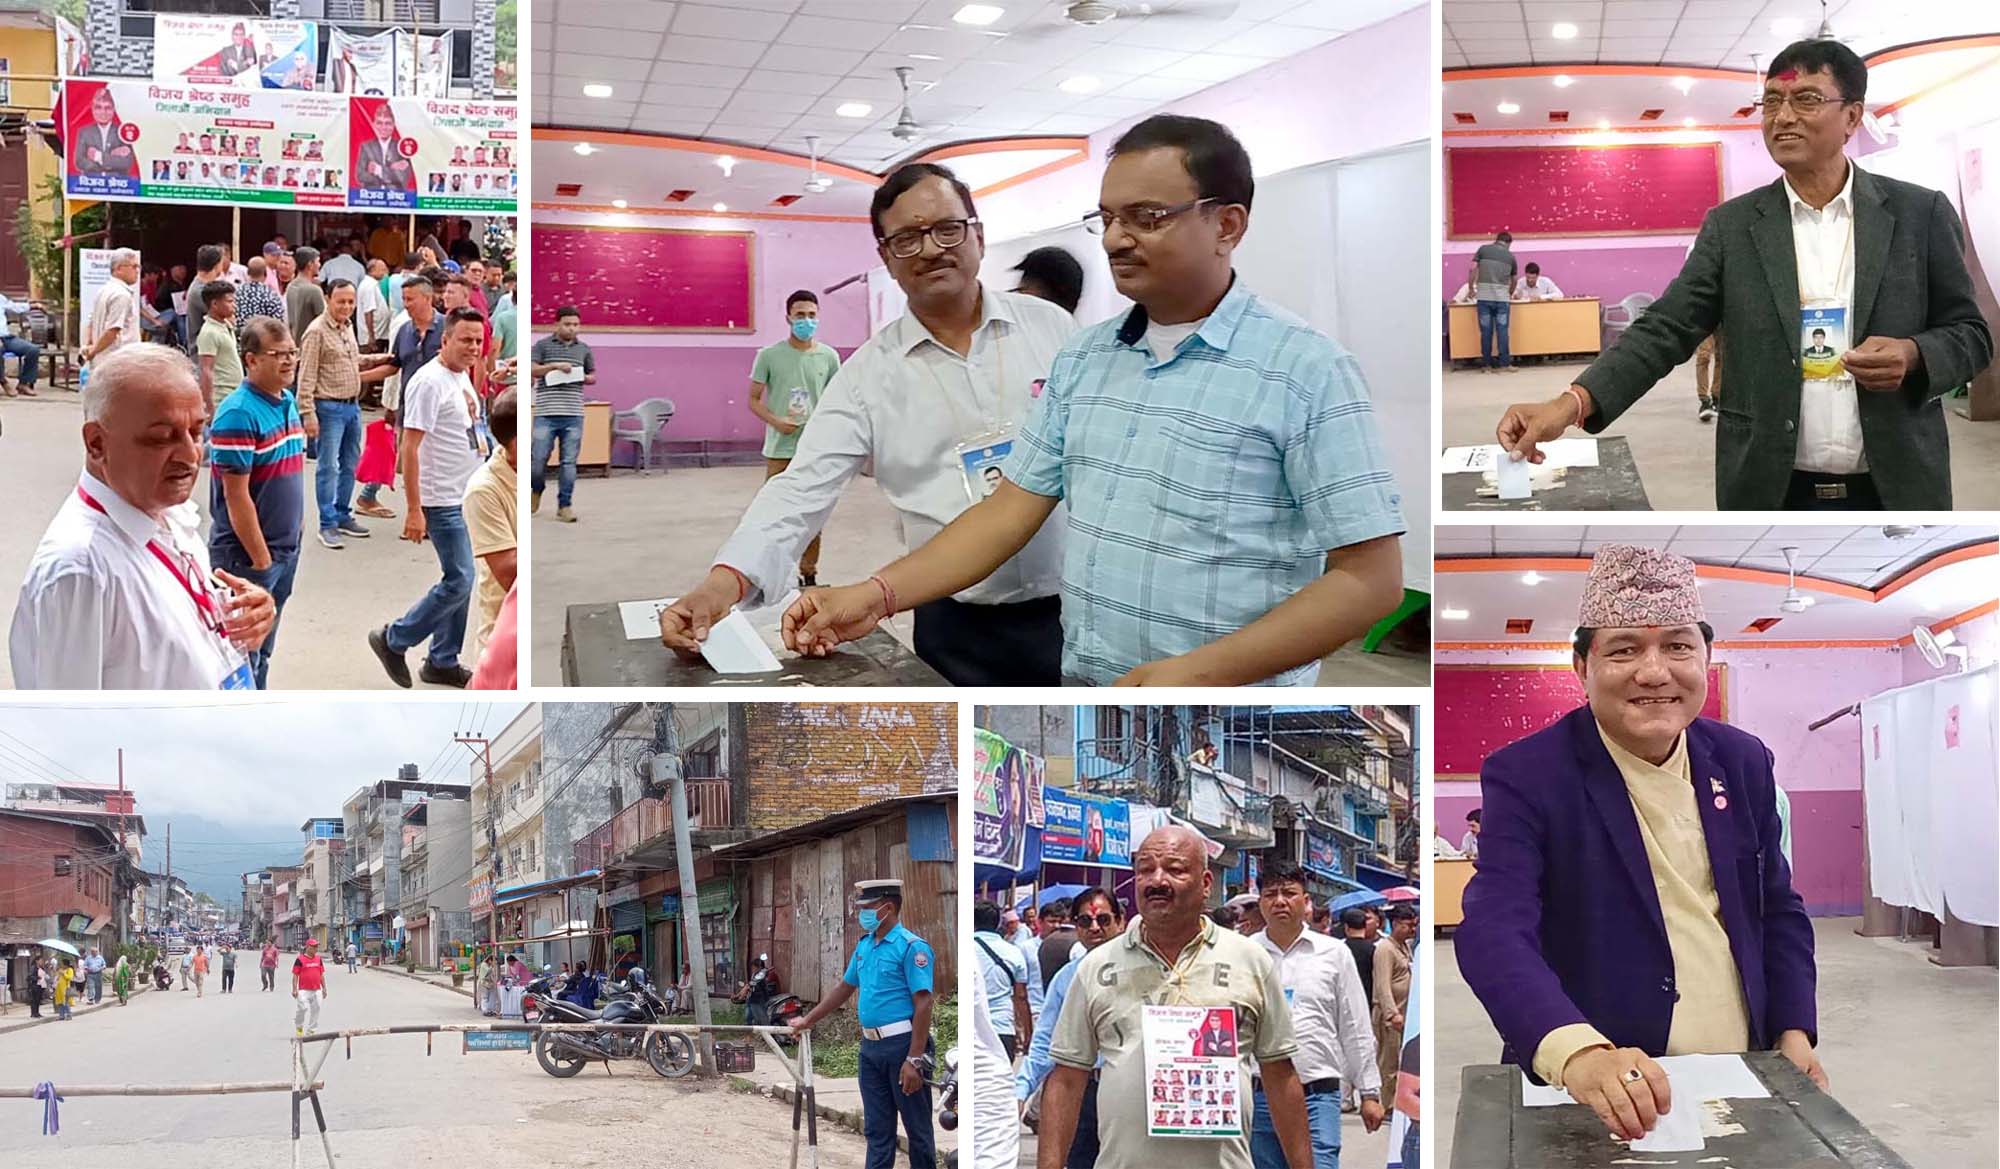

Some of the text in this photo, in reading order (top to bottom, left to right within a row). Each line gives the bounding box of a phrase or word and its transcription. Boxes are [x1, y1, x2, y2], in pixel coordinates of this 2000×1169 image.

[148, 85, 252, 109] विजय श्रेष्ठ समुह
[426, 101, 460, 115] विजय
[493, 105, 518, 121] समु
[1097, 962, 1231, 987] G E
